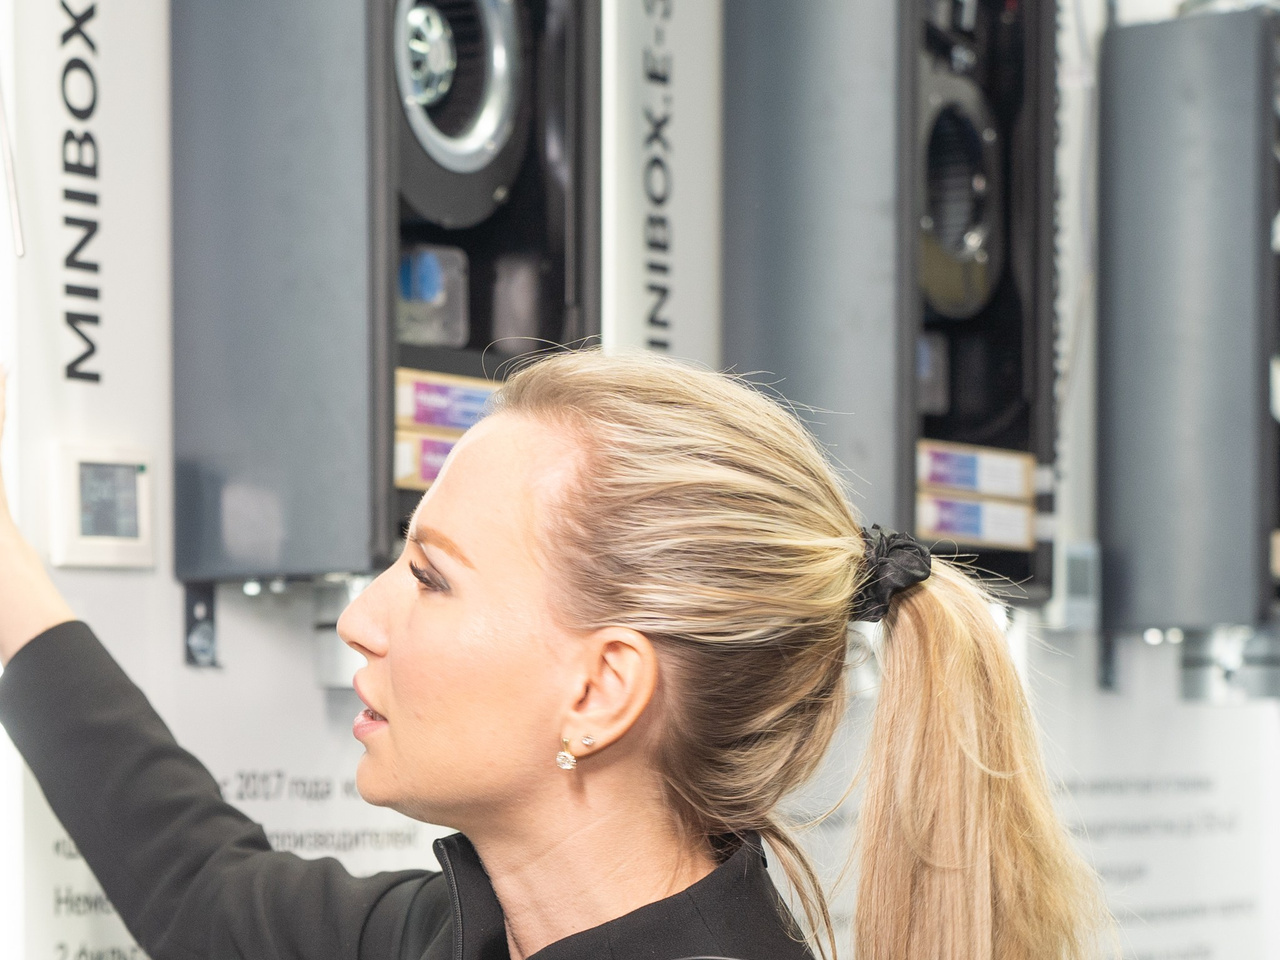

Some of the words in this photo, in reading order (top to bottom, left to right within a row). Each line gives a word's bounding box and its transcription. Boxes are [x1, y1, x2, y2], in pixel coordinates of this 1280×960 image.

[60, 0, 100, 383] MINIBOX
[644, 0, 670, 349] INIBOX.E-
[235, 770, 284, 801] 2017
[288, 778, 332, 806] года
[54, 887, 113, 916] Неме
